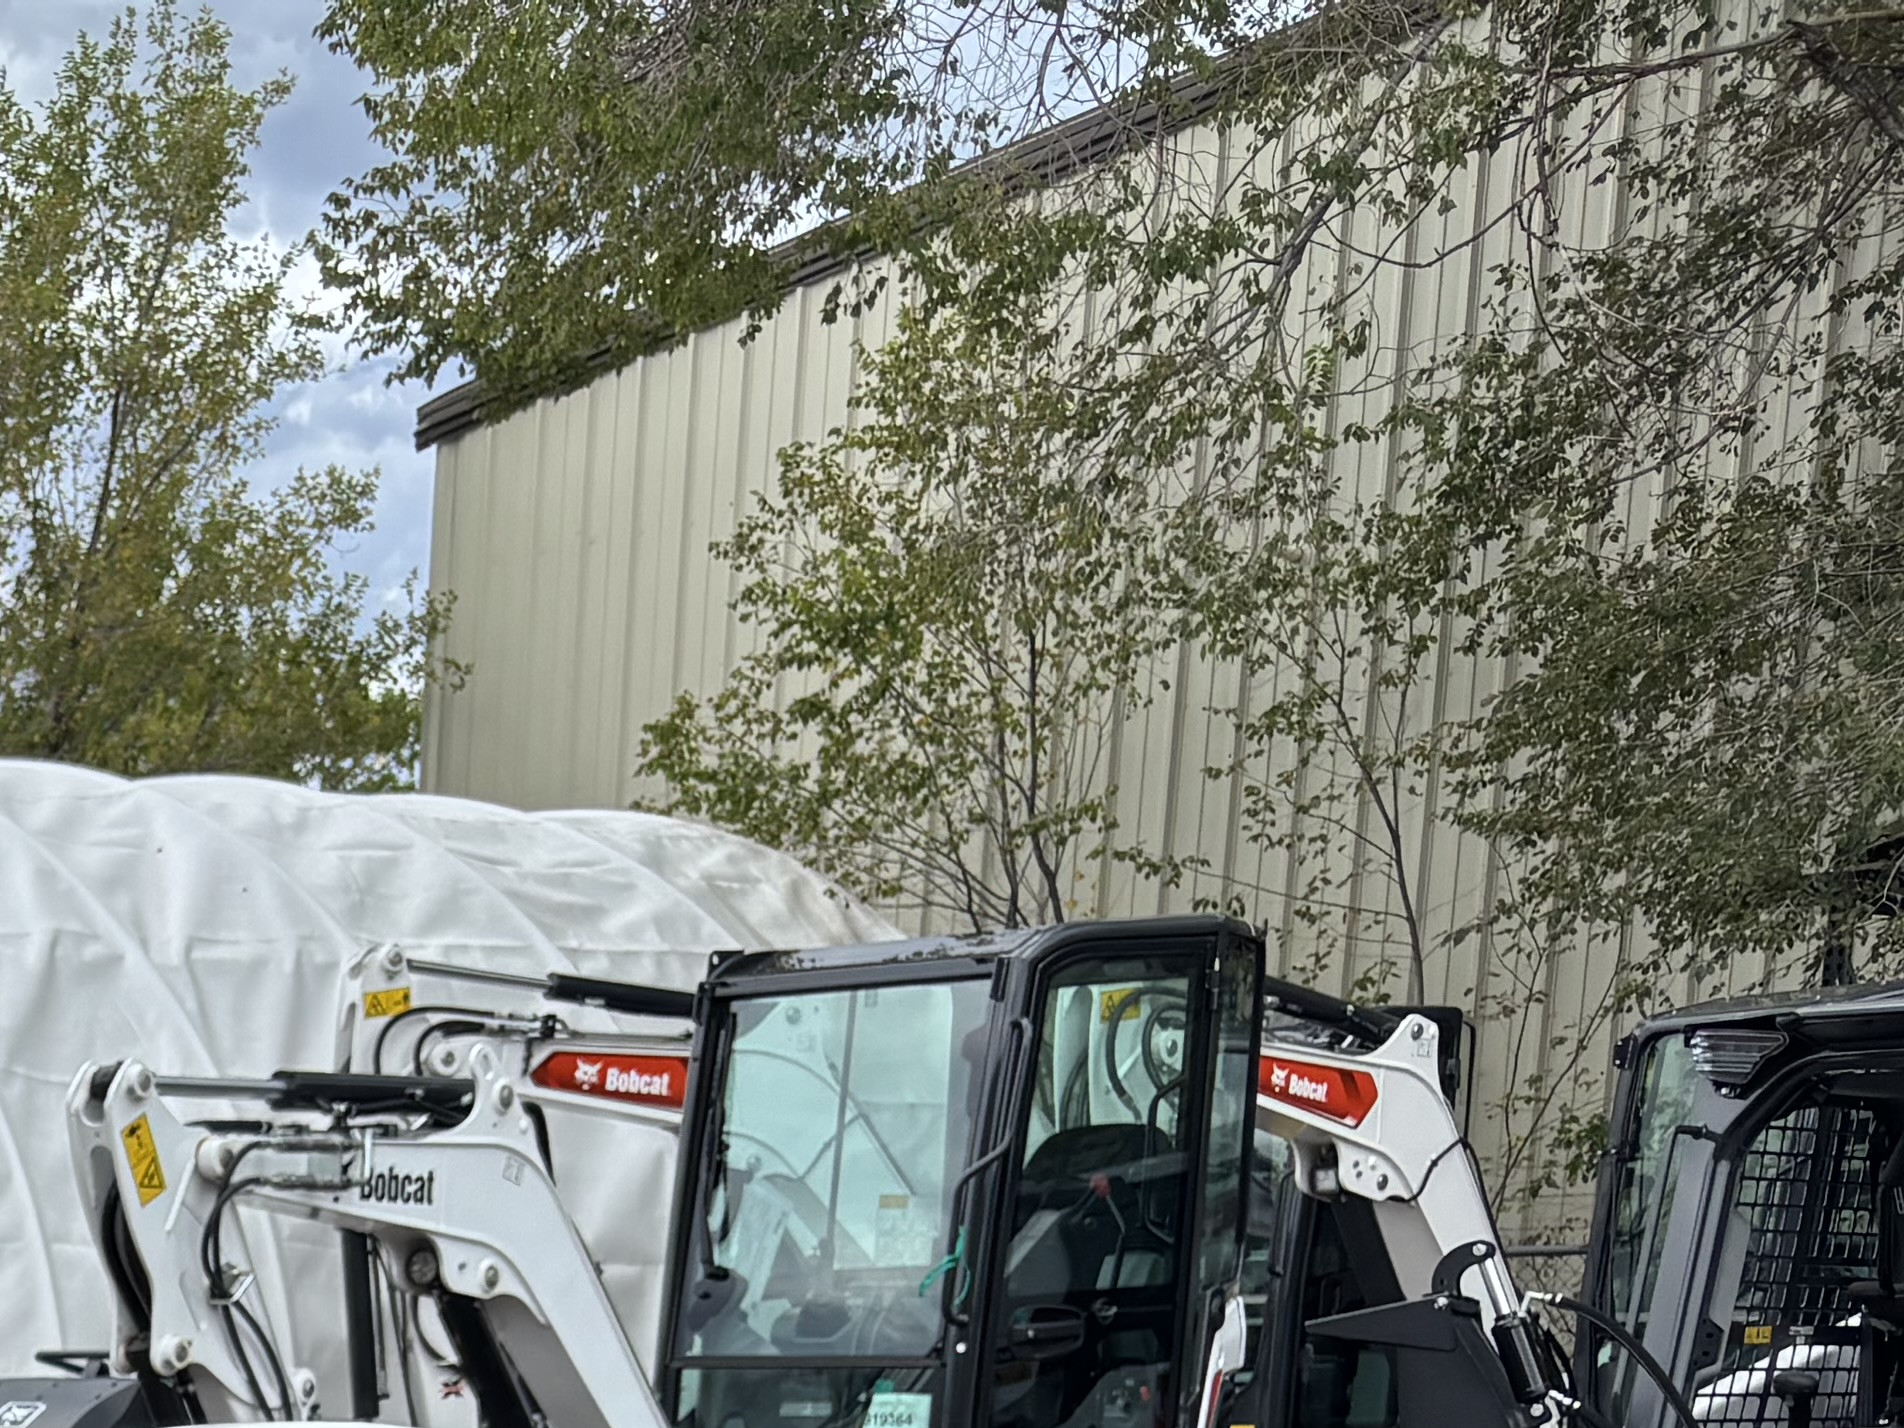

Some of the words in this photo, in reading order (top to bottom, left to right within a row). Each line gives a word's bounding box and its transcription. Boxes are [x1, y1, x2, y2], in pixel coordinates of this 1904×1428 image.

[605, 1066, 670, 1097] Bobcat
[1288, 1073, 1329, 1103] Bobcat
[360, 1166, 434, 1206] Bobcat
